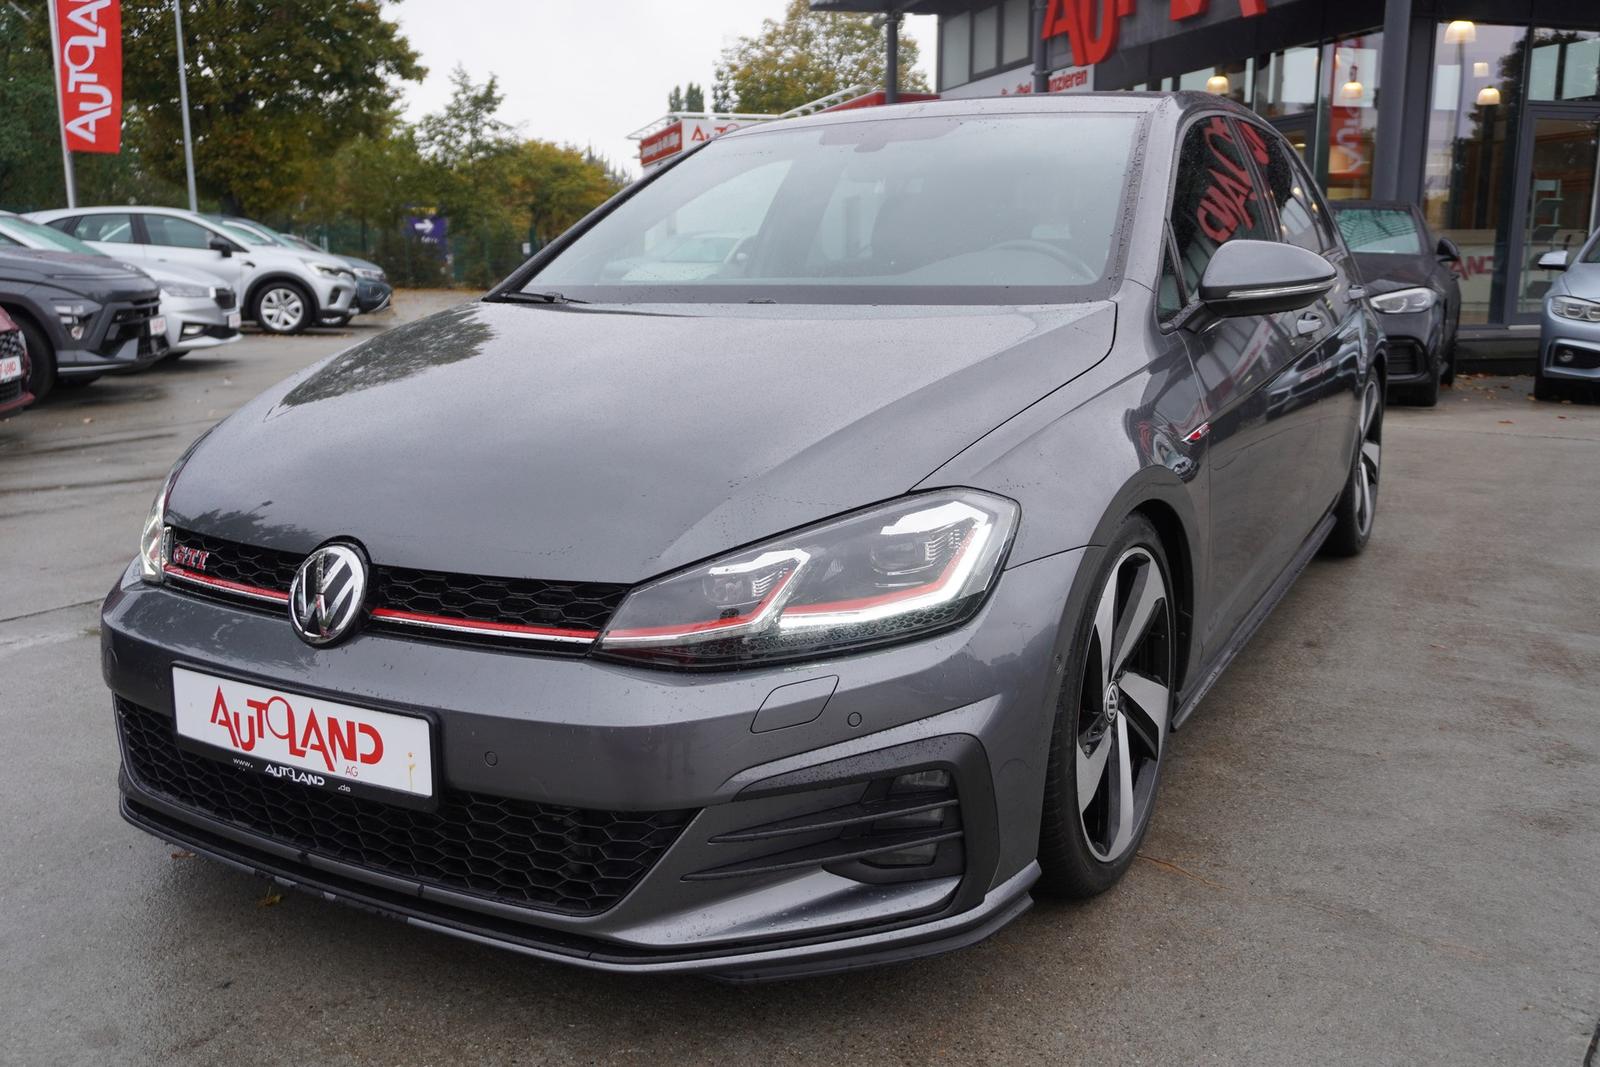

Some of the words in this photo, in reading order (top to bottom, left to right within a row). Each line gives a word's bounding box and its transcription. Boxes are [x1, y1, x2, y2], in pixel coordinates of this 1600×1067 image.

[64, 0, 112, 143] AUTOLA
[1048, 70, 1088, 93] nzieren
[173, 544, 210, 570] GTI
[210, 685, 384, 772] AUTOLAND
[264, 763, 326, 787] AUTOLAND
[337, 783, 351, 792] .de
[345, 765, 359, 778] AG
